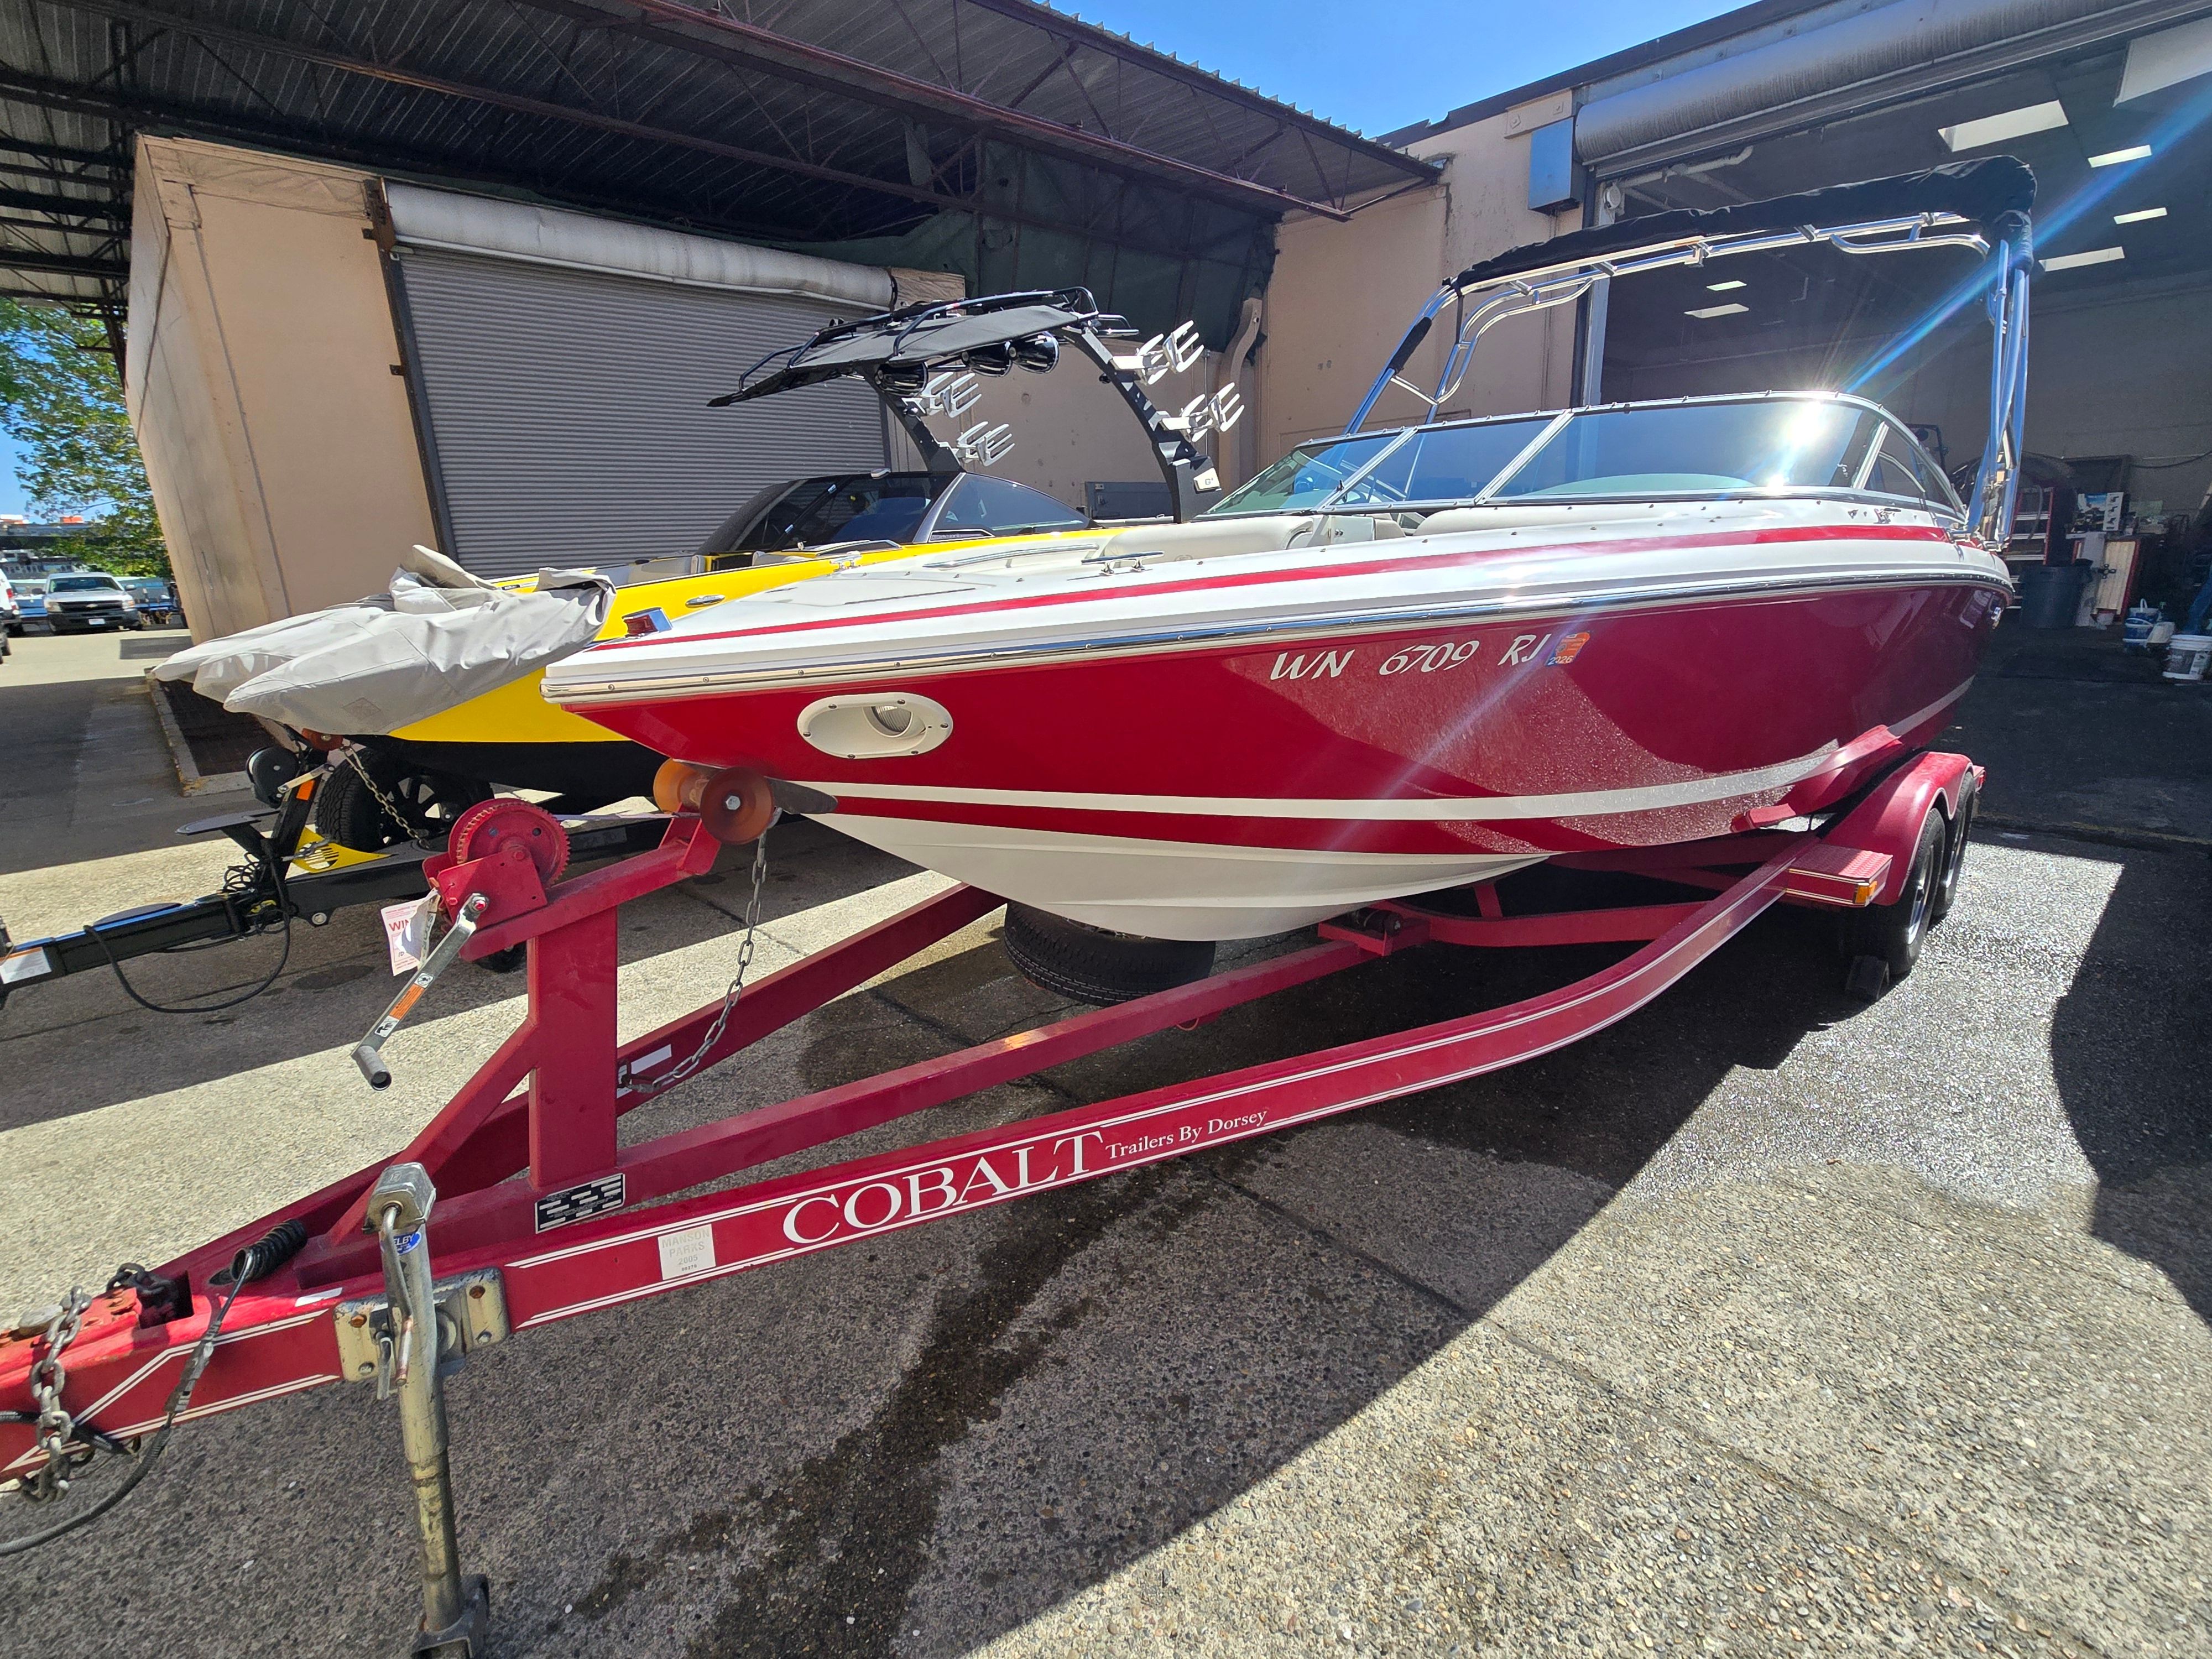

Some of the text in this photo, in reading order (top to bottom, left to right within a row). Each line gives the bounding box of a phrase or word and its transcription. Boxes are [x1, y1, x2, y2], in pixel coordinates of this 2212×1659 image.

[1270, 649, 1355, 680] WN
[1379, 640, 1480, 675] 6709
[1498, 633, 1552, 666] RJ
[1548, 656, 1574, 665] 2026
[783, 1110, 1267, 1244] COBALT Trailers By Dorsey
[661, 1228, 709, 1248] MANSON
[679, 1254, 698, 1265] 2005
